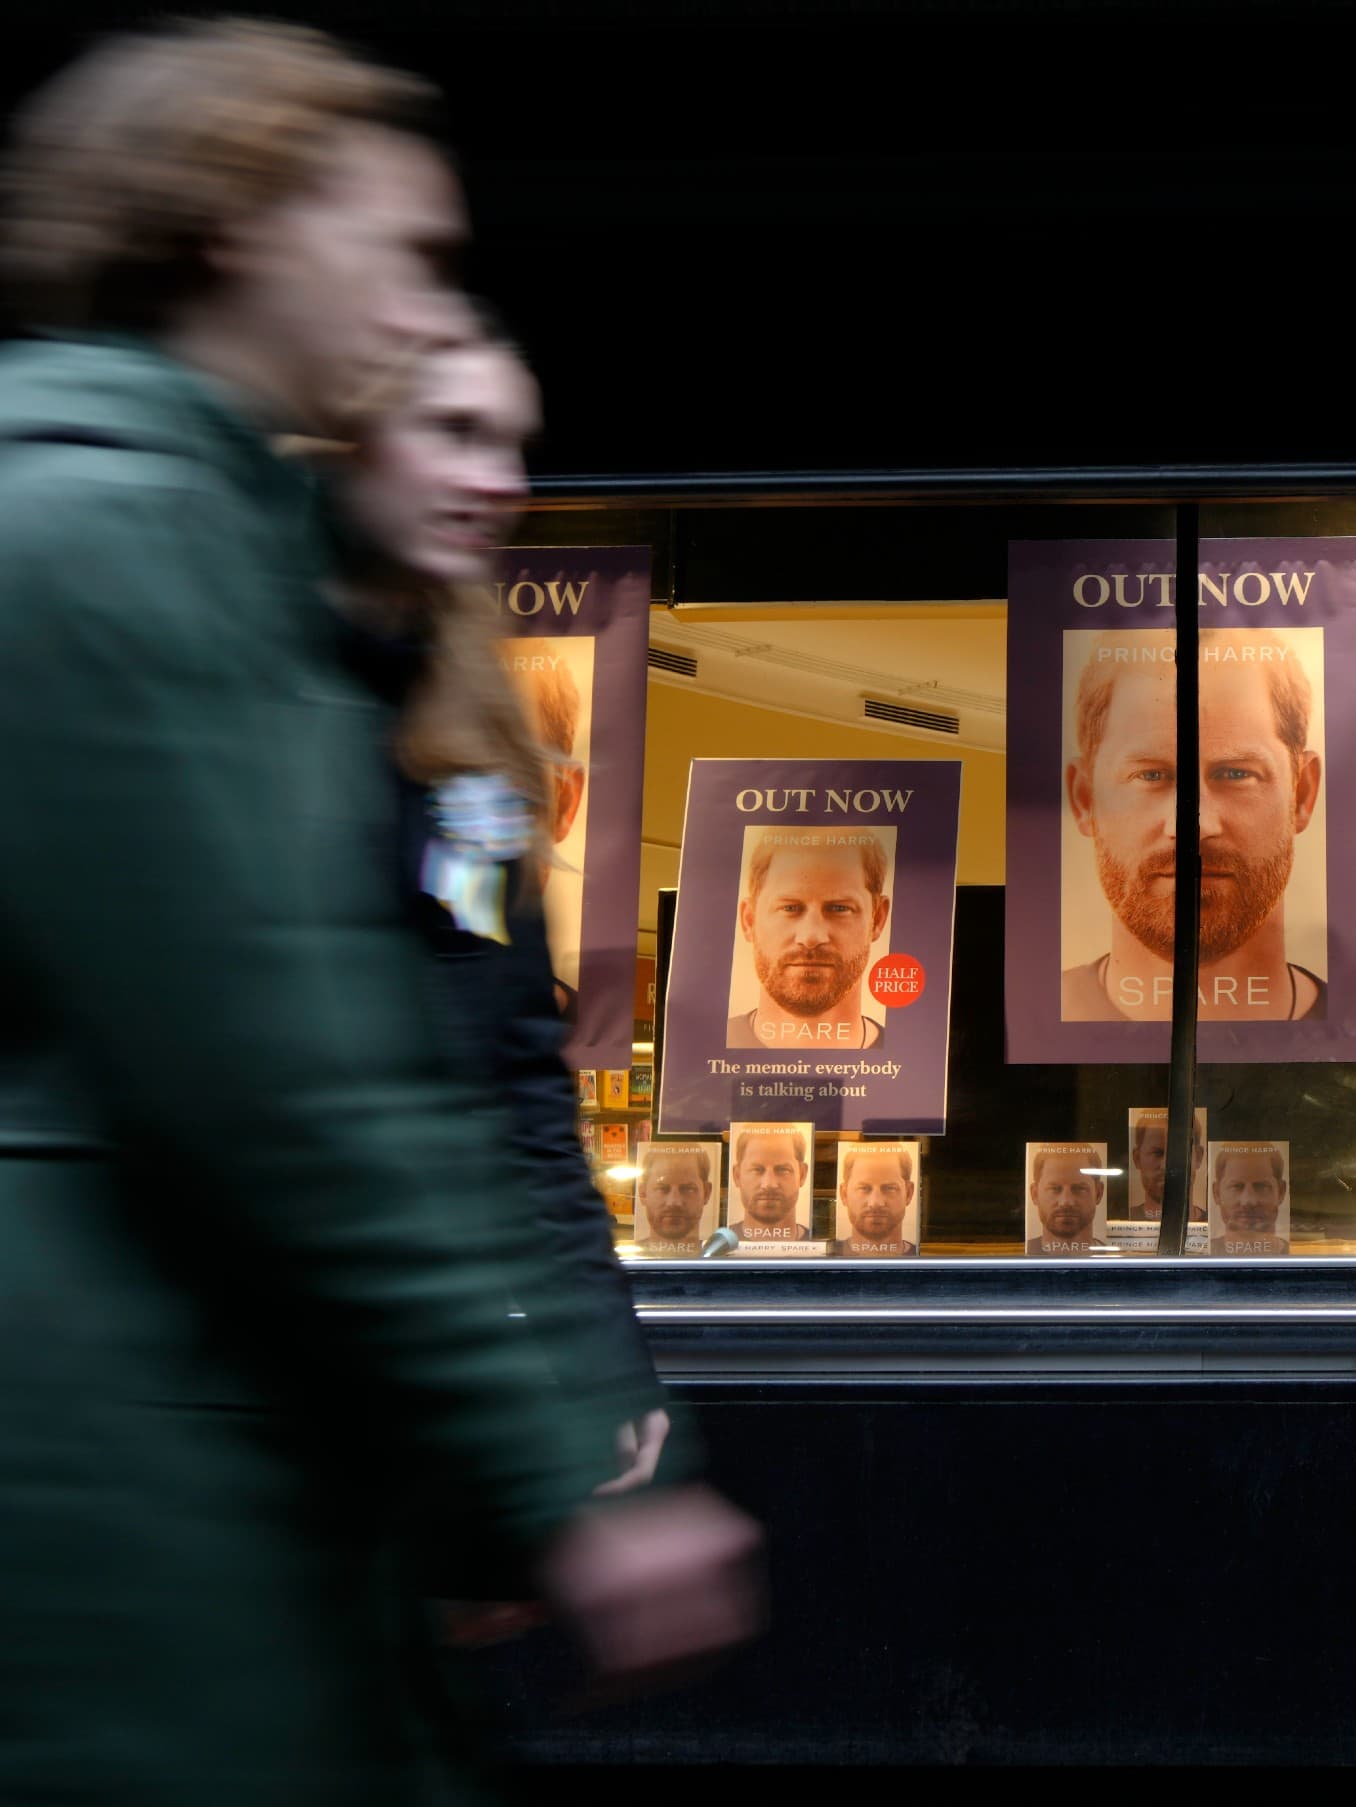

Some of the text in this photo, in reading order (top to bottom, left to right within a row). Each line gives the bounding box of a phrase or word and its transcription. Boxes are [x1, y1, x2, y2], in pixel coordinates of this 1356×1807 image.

[1072, 571, 1315, 608] OUT NOW
[1097, 645, 1289, 663] PRINC HARRY
[735, 788, 914, 813] OUT NOW
[763, 834, 877, 847] PRINCE HARRY
[877, 966, 919, 980] HALF
[874, 980, 919, 994] PRICE
[760, 1021, 851, 1042] SPARE
[707, 1058, 902, 1079] The memoir everybody
[739, 1081, 867, 1101] is talking about
[740, 1127, 801, 1135] PRINCE HARRY
[744, 1227, 791, 1238] SPARE
[650, 1241, 696, 1251] SPARE
[852, 1243, 897, 1252] SPARE
[1042, 1241, 1089, 1251] SPARE
[1225, 1241, 1273, 1253] SPARE
